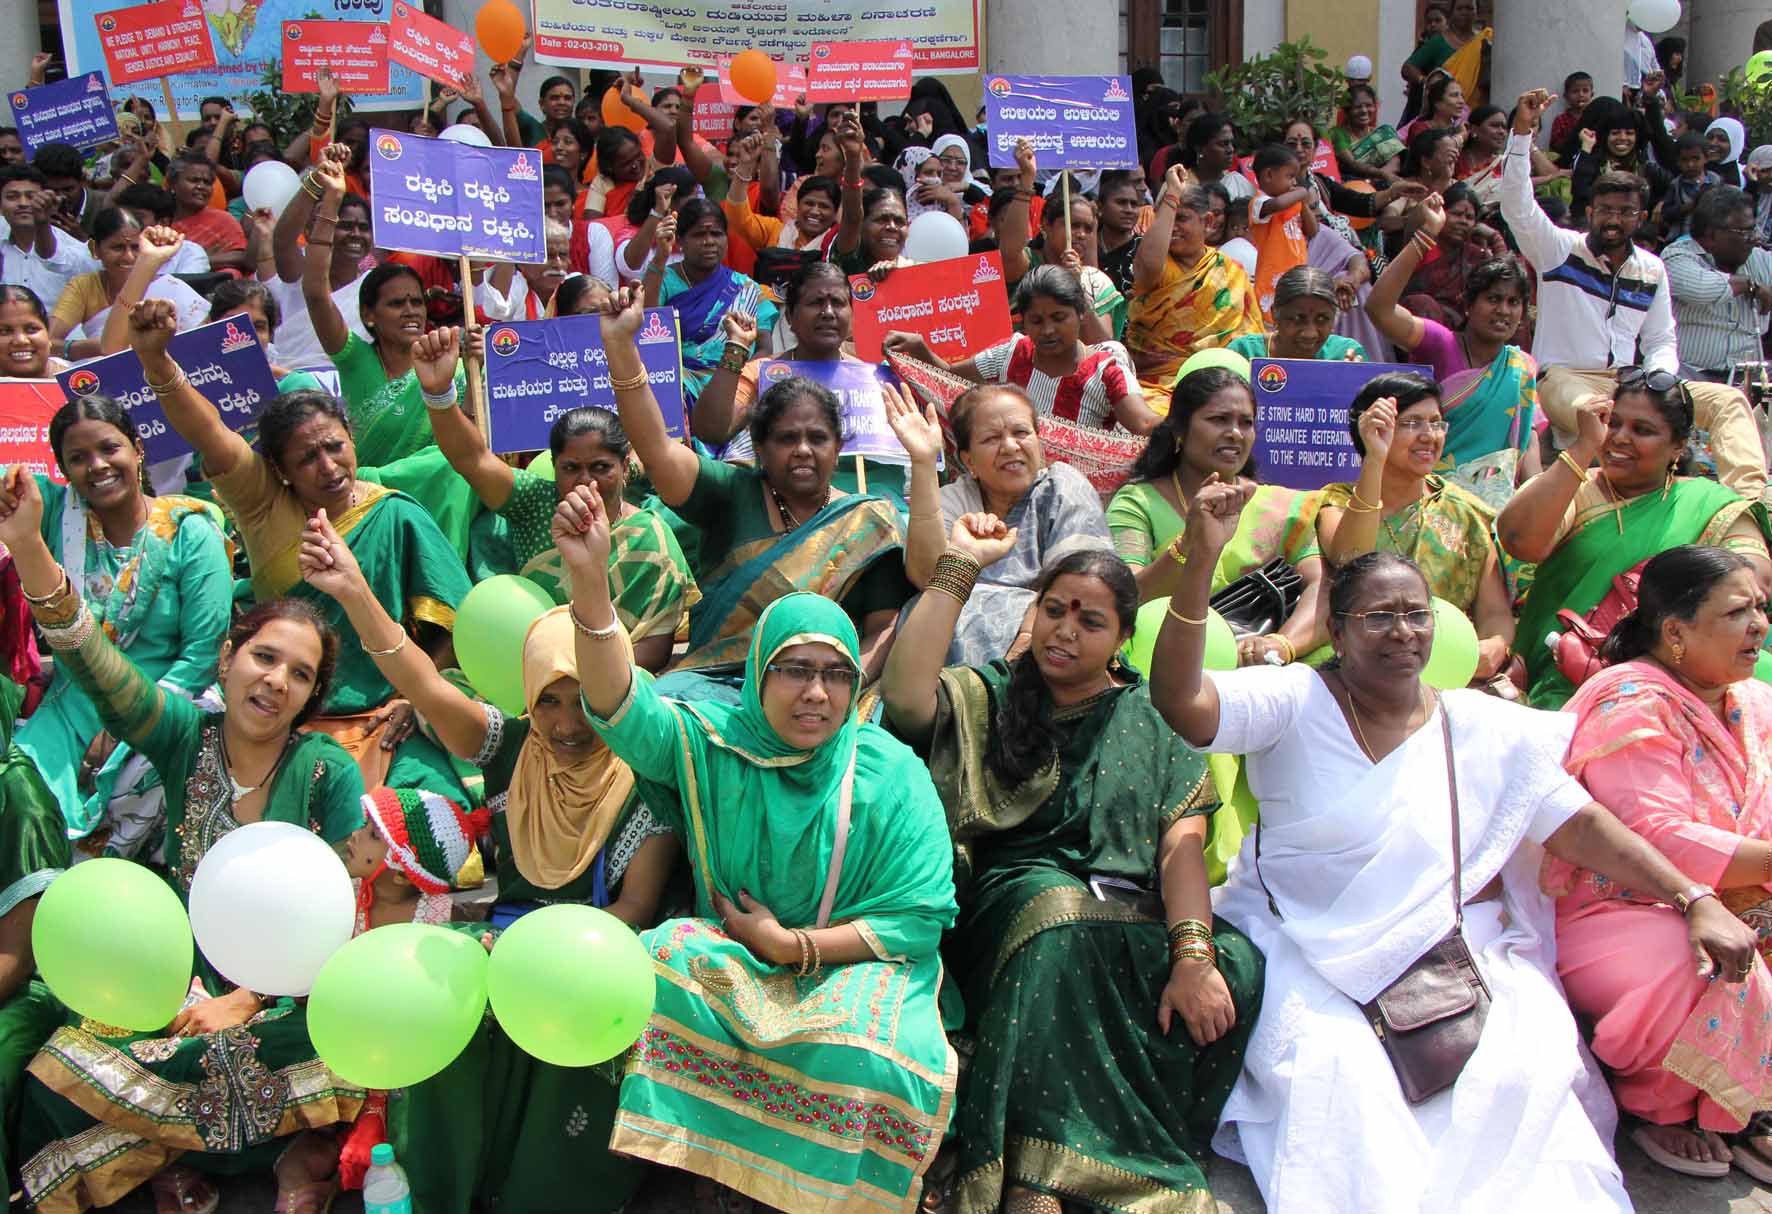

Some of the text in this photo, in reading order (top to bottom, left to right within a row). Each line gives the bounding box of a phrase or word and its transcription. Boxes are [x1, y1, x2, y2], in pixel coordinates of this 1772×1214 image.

[540, 37, 562, 48] Date
[930, 49, 976, 59] BANGALORE
[1000, 104, 1056, 121] ಉಳಿಯಲಿ
[405, 171, 511, 211] ರಕ್ಷಿಸಿ ರಕ್ಷಿಸಿ
[383, 204, 535, 247] ಸಂವಿಧಾನ ರಕ್ಷಿಸಿ.
[877, 289, 980, 323] ಸಂವಿಧಾನದ ಸಂರಕ್ಷಣೆ
[929, 321, 968, 347] ಕರ್ತವ್ಯ
[492, 378, 553, 399] ಮಹಿಳೆಯರ
[558, 375, 589, 396] ಮತ್ತು
[218, 387, 260, 414] ರಕ್ಷಿಸಿ
[1268, 407, 1292, 422] STRIVE
[1295, 407, 1314, 423] HARD
[1318, 408, 1327, 423] TO
[1330, 409, 1350, 424] PROT
[1265, 428, 1307, 444] GUARANTEE
[1269, 450, 1279, 464] TO
[1280, 450, 1294, 465] THE
[1299, 450, 1333, 466] PRINCIPLE
[1338, 453, 1348, 467] OF
